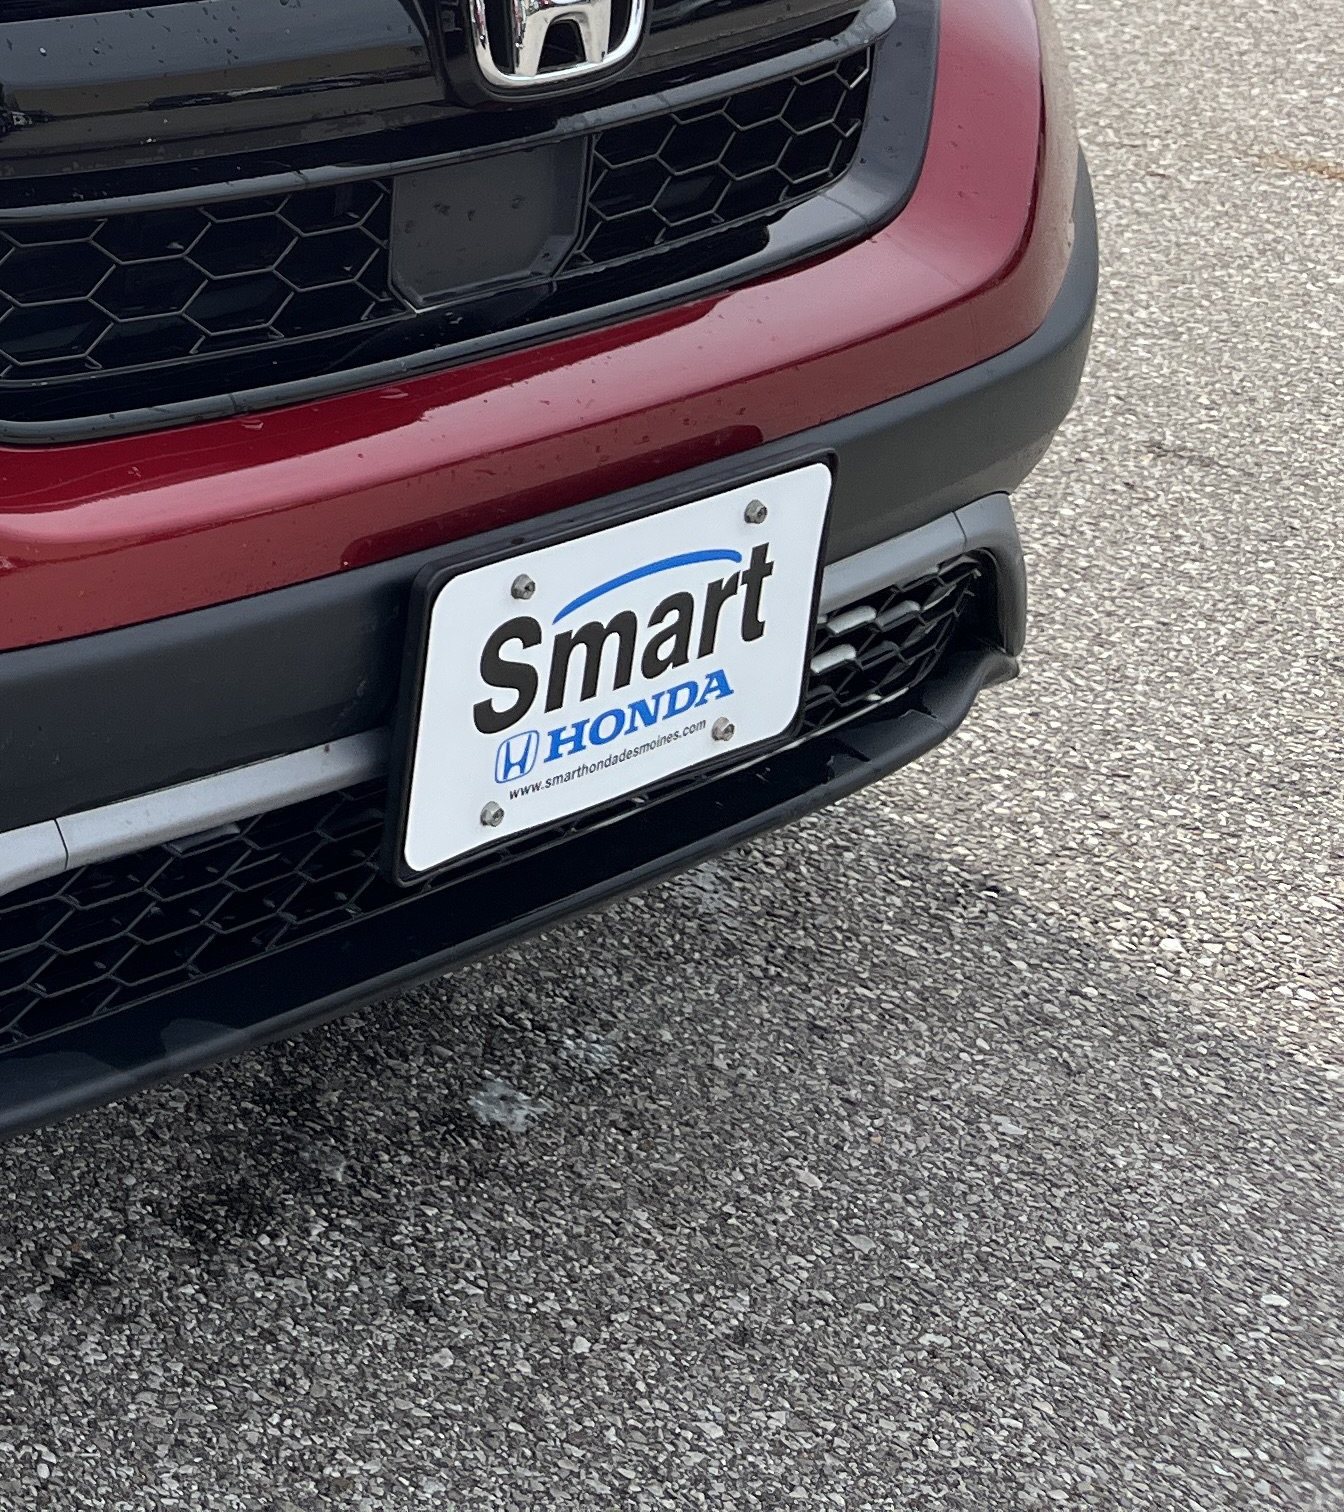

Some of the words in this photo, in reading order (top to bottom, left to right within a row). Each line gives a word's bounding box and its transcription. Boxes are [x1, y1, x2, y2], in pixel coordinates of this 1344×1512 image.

[472, 542, 776, 736] Smart
[509, 718, 707, 801] www.smarthondadesmoines.com
[543, 669, 735, 763] HONDA
